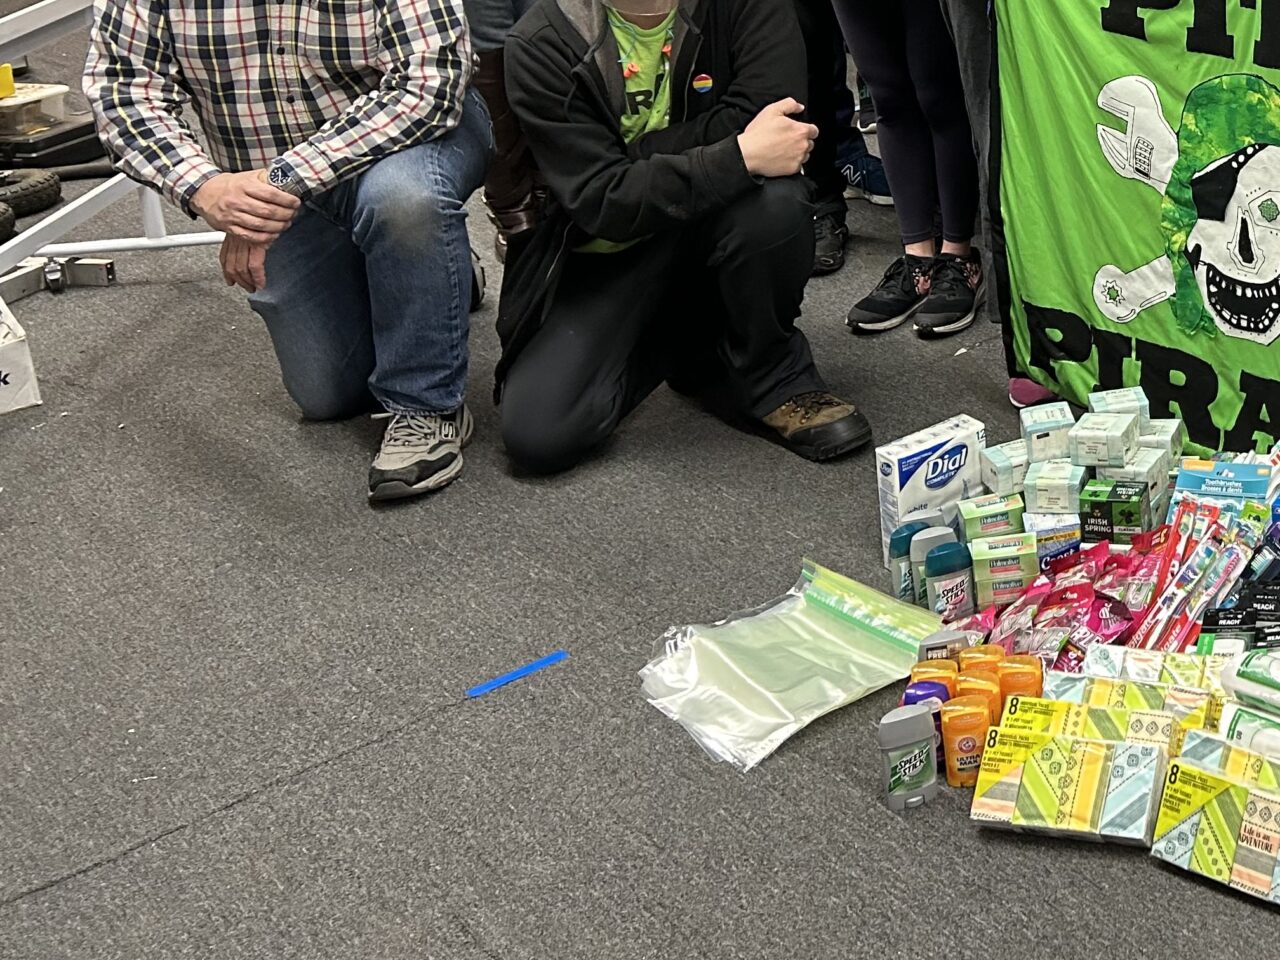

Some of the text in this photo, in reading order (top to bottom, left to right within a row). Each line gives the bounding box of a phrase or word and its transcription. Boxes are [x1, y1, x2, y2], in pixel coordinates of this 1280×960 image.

[926, 447, 967, 480] Dial
[1205, 478, 1242, 488] Toothbrushes
[1084, 524, 1112, 533] SPRING
[1087, 518, 1108, 526] IRISH
[941, 578, 966, 599] SPEED
[945, 587, 966, 605] STICK
[1008, 697, 1019, 715] 8
[987, 729, 998, 748] 8
[898, 749, 924, 770] SPEED
[902, 756, 926, 777] STICK
[957, 754, 980, 762] ULTRA
[1168, 763, 1180, 785] 8
[1243, 822, 1271, 842] Life is an
[1240, 834, 1273, 854] ADVENTURE
